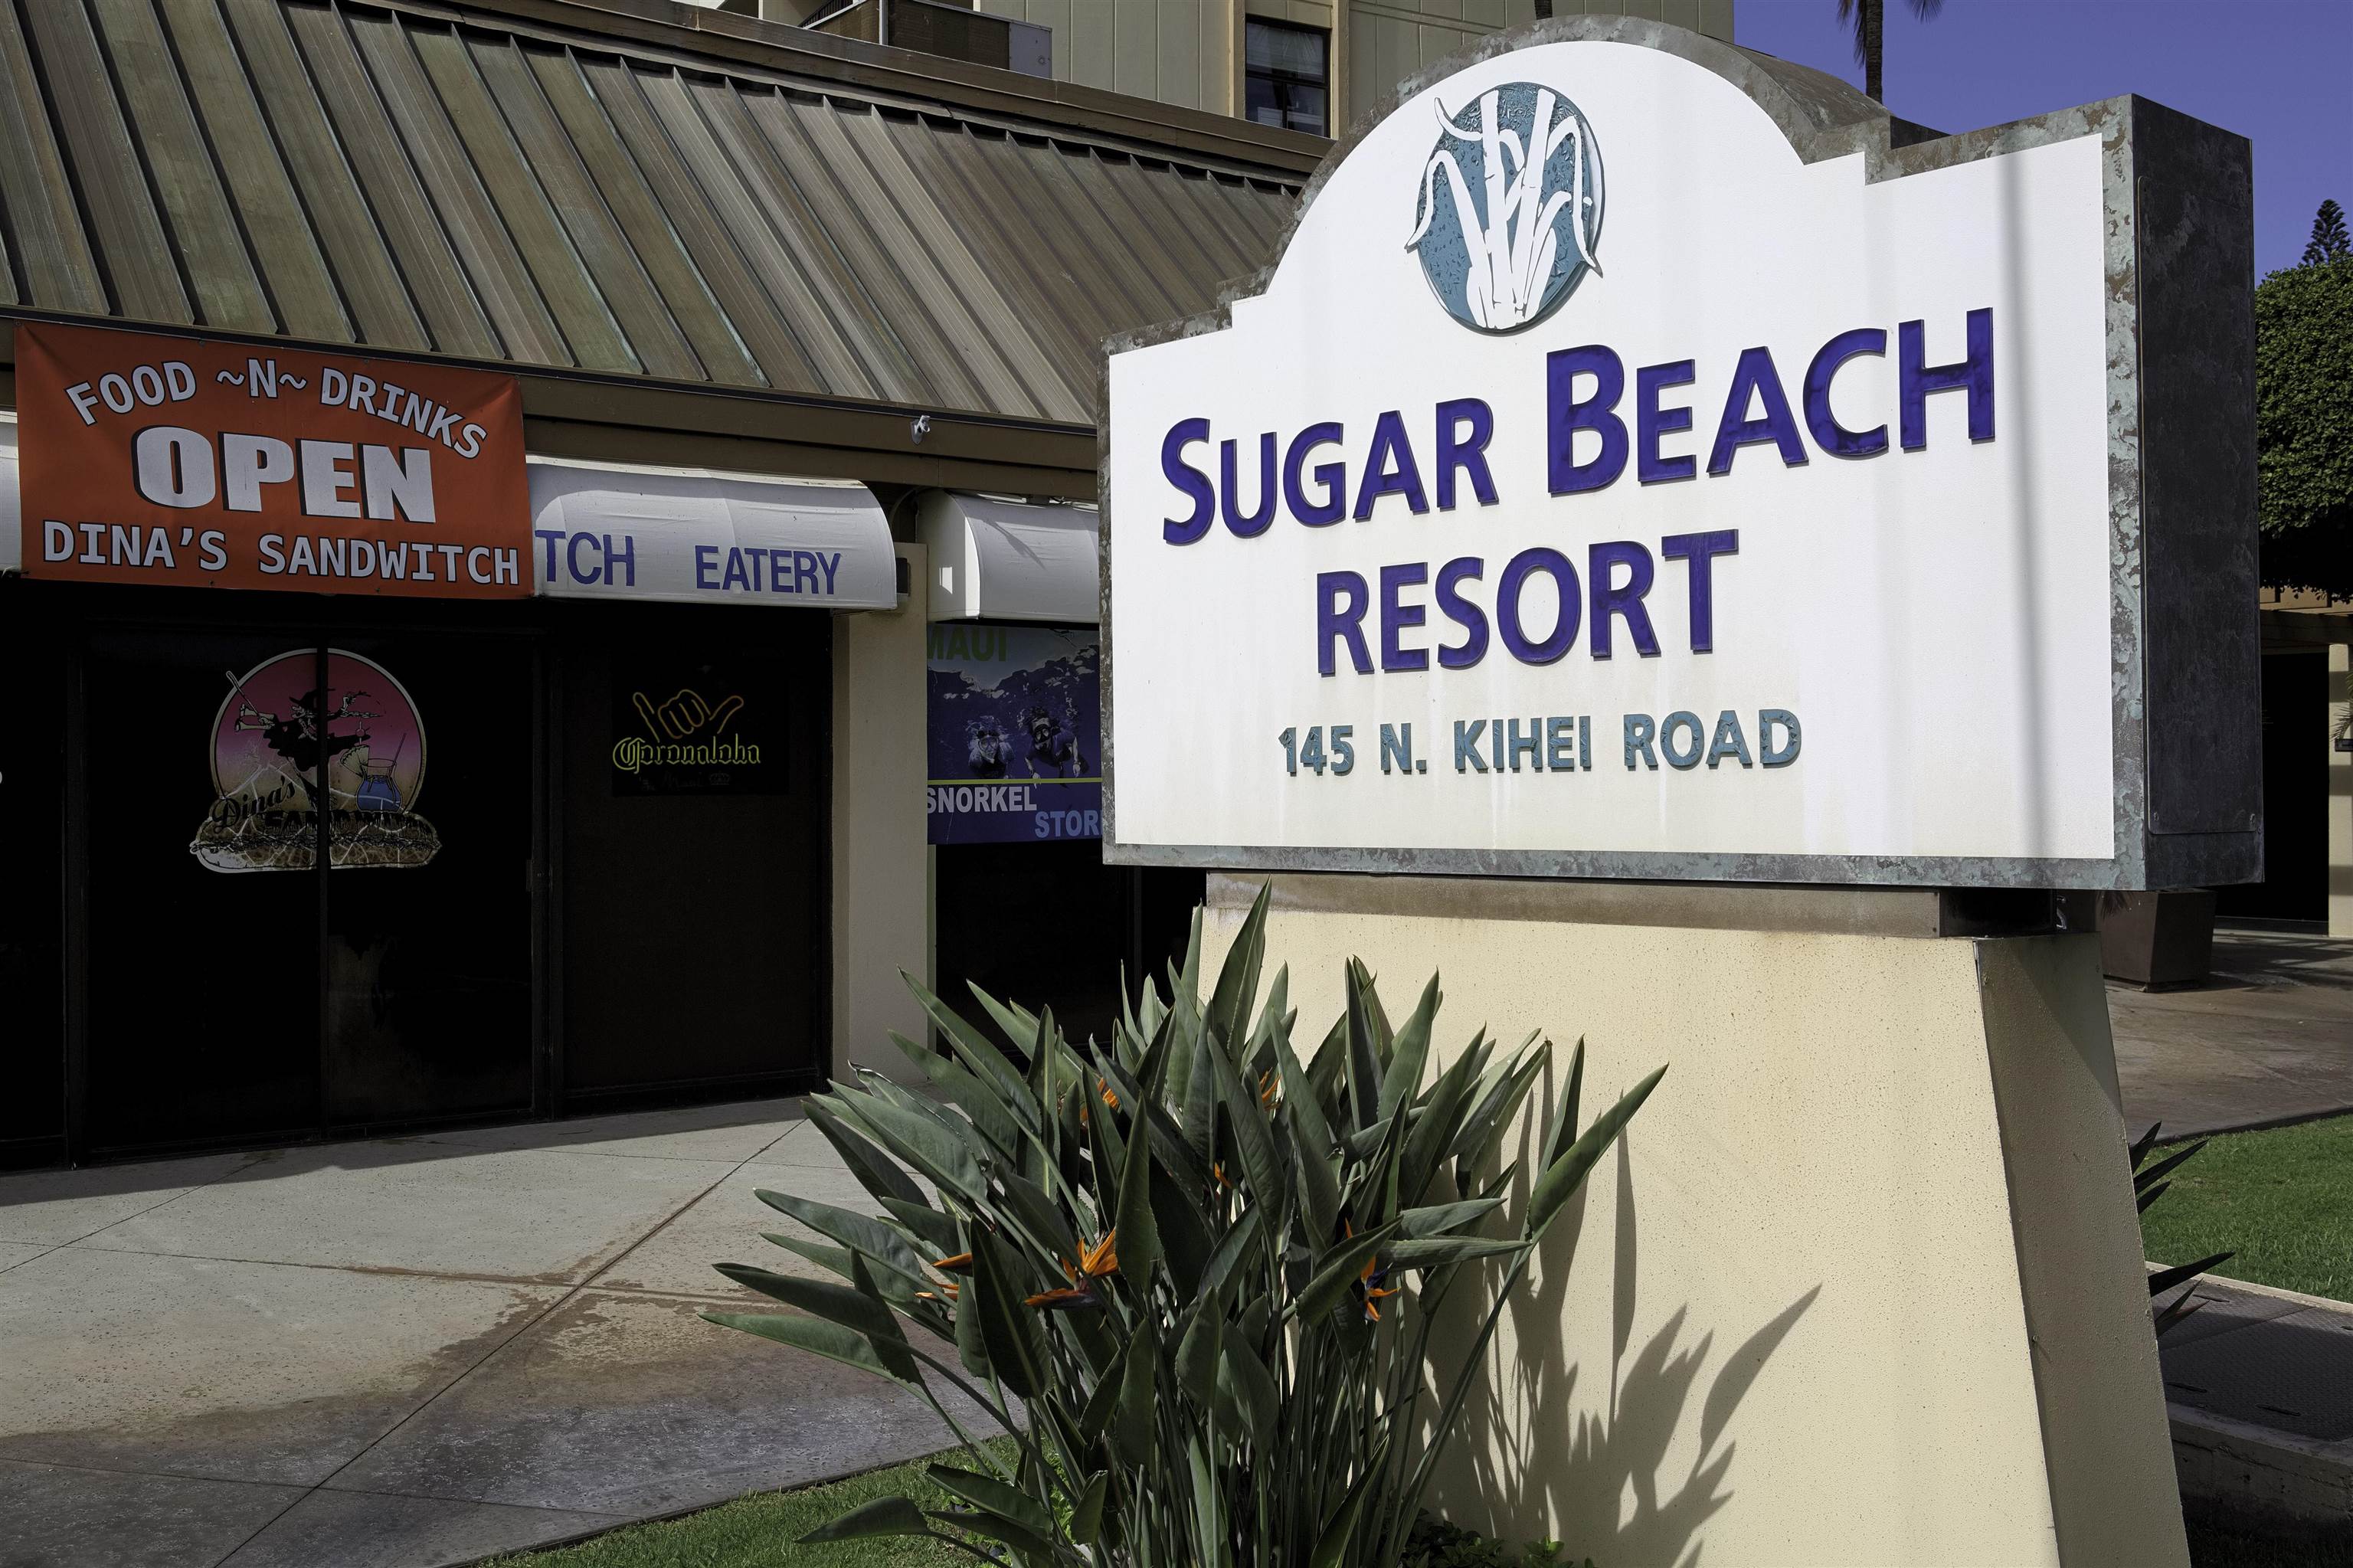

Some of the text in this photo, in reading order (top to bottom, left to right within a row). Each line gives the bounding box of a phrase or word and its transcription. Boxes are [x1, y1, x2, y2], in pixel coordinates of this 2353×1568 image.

[65, 361, 197, 427] FOOD
[320, 366, 487, 460] DRINKS
[1161, 307, 1995, 546] SUGAR BEACH
[132, 425, 437, 524] OPEN
[44, 520, 519, 586] DINA'S SANDWITCH
[695, 545, 841, 594] EATERY
[1317, 529, 1739, 678] RESORT
[1278, 709, 1802, 777] 145 N. KIHEI ROAD
[1035, 810, 1102, 839] STOR
